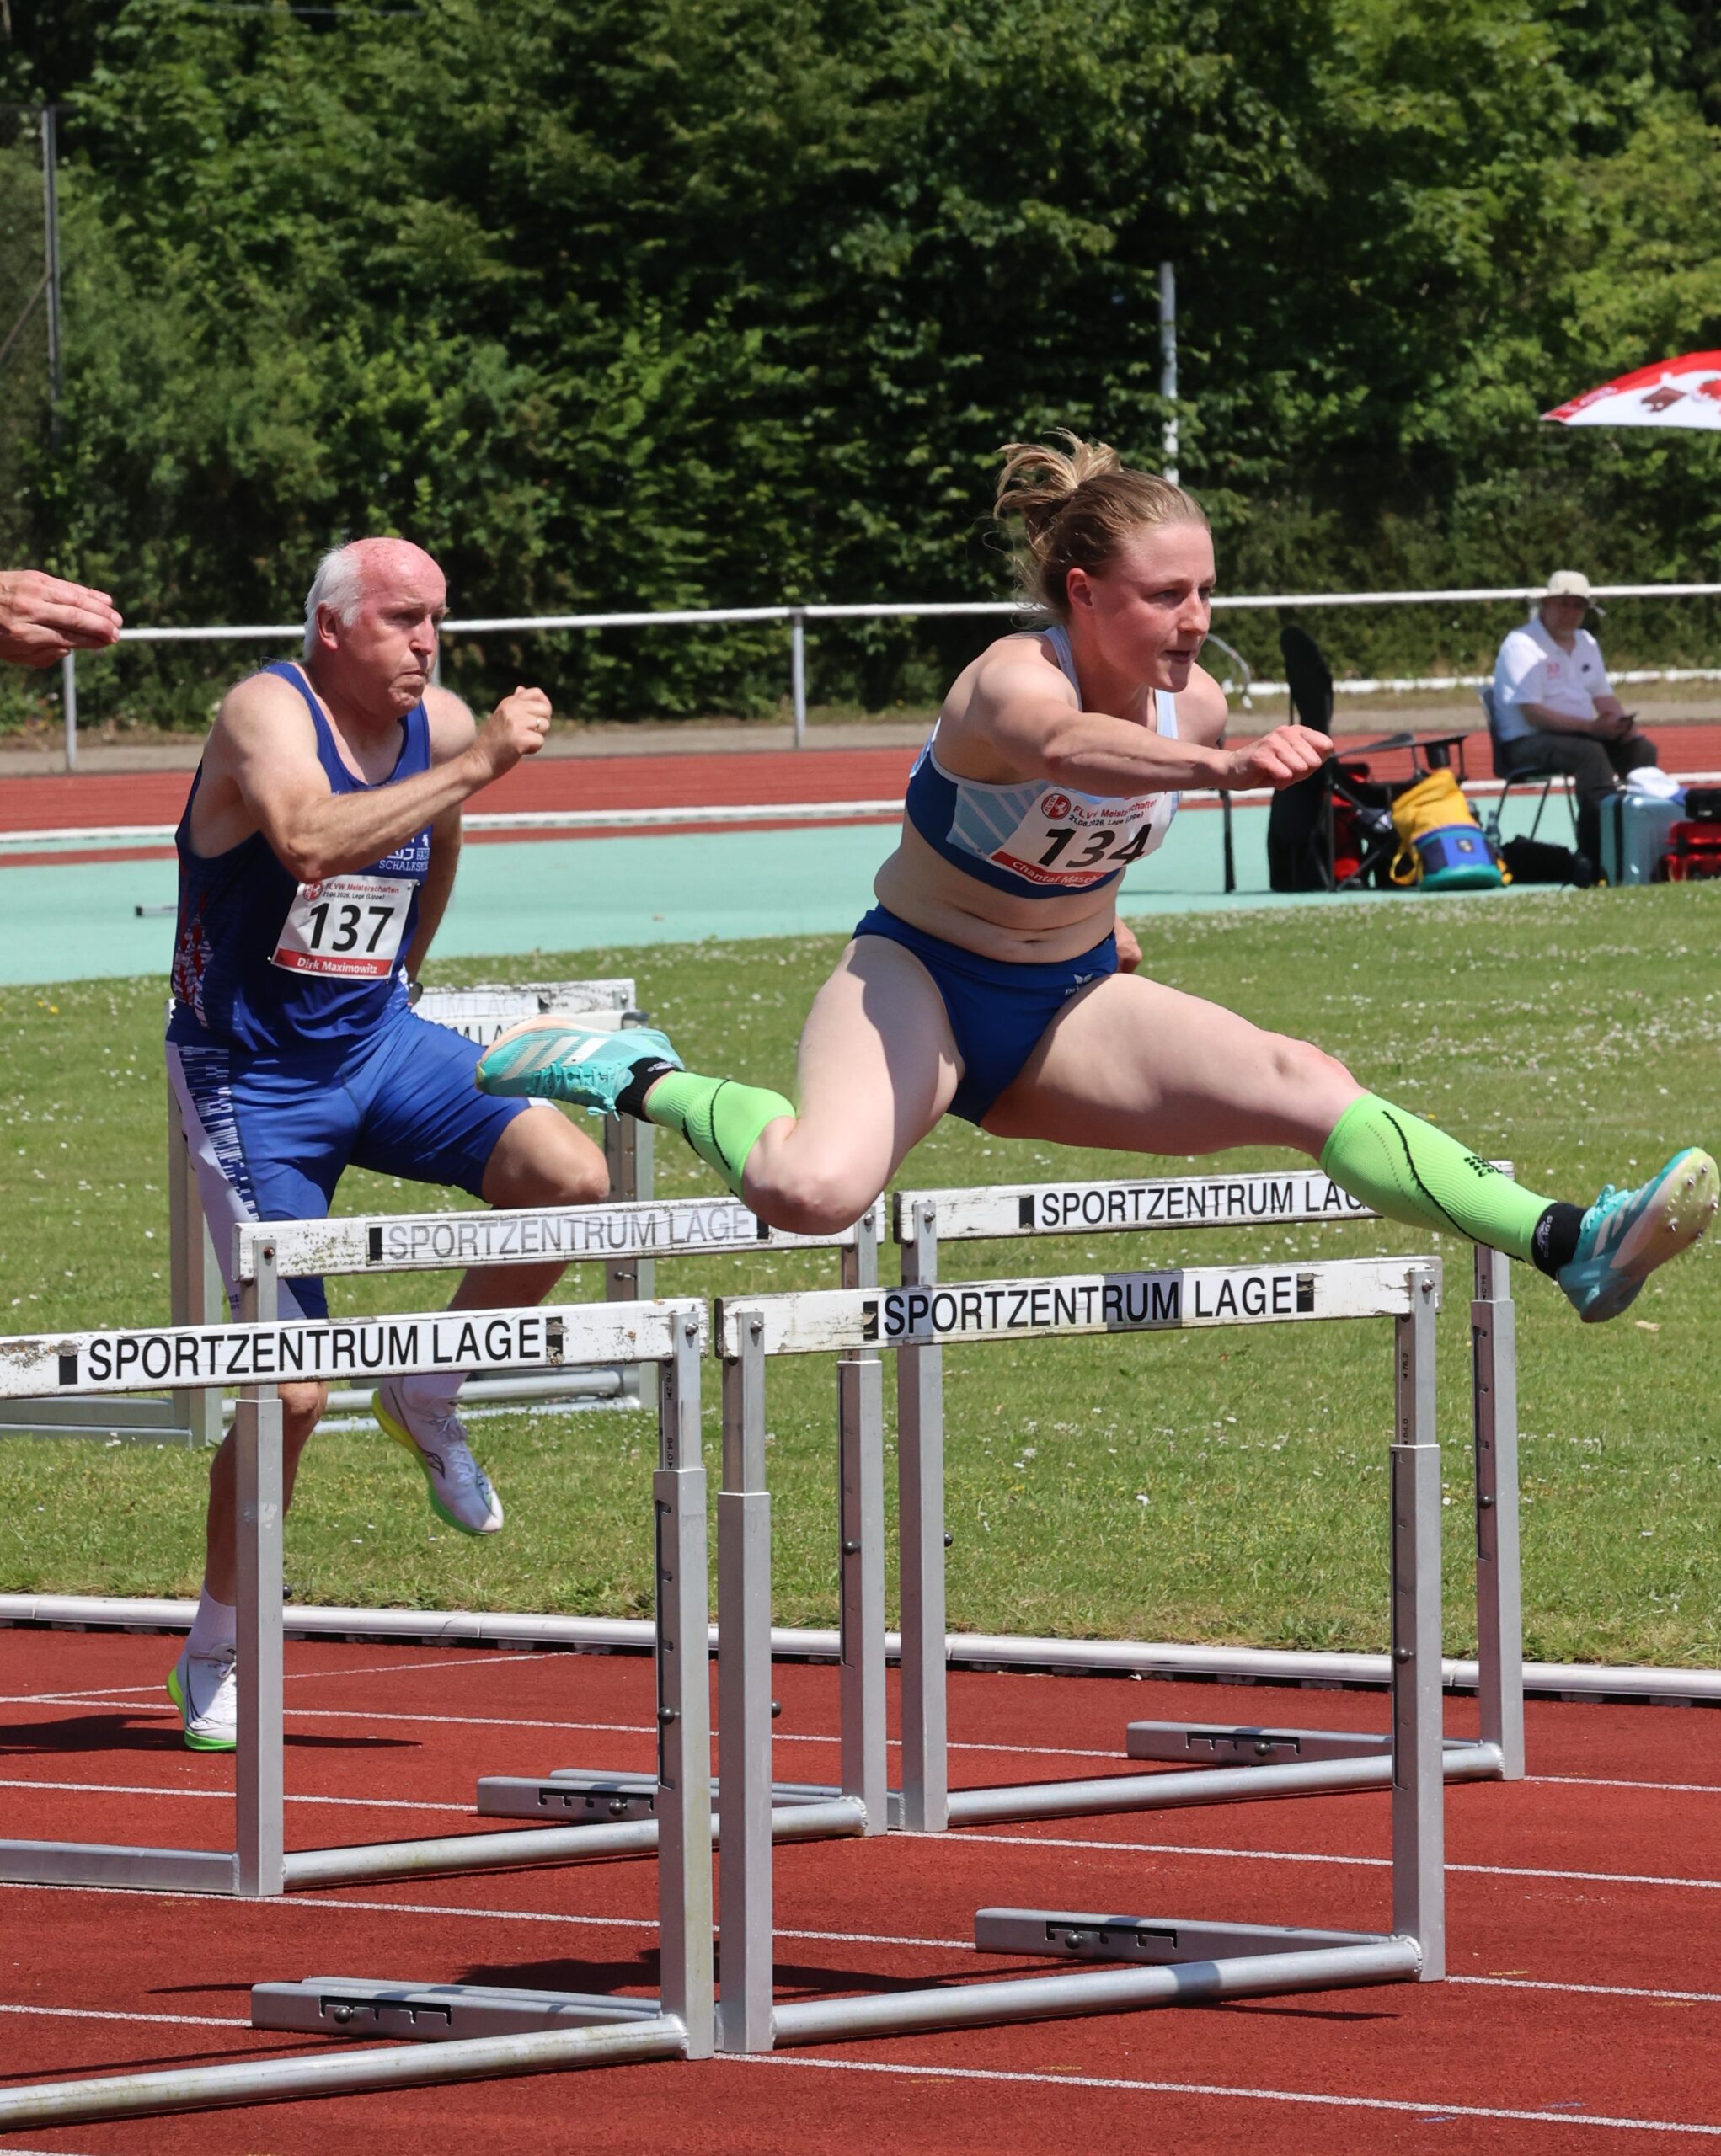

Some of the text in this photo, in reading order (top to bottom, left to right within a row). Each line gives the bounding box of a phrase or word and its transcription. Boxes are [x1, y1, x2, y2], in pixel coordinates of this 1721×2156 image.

[1038, 823, 1152, 868] 134
[347, 883, 398, 894] Meisterschaften
[1012, 861, 1059, 883] Chantal
[310, 903, 395, 953] 137
[297, 957, 377, 974] Dirk Maximowitz
[1042, 1181, 1293, 1227] SPORTZENTRUM
[389, 1206, 750, 1261] SPORTZENTRUM LAGE
[885, 1276, 1291, 1336] SPORTZENTRUM LAGE
[88, 1319, 541, 1380] SPORTZENTRUM LAGE
